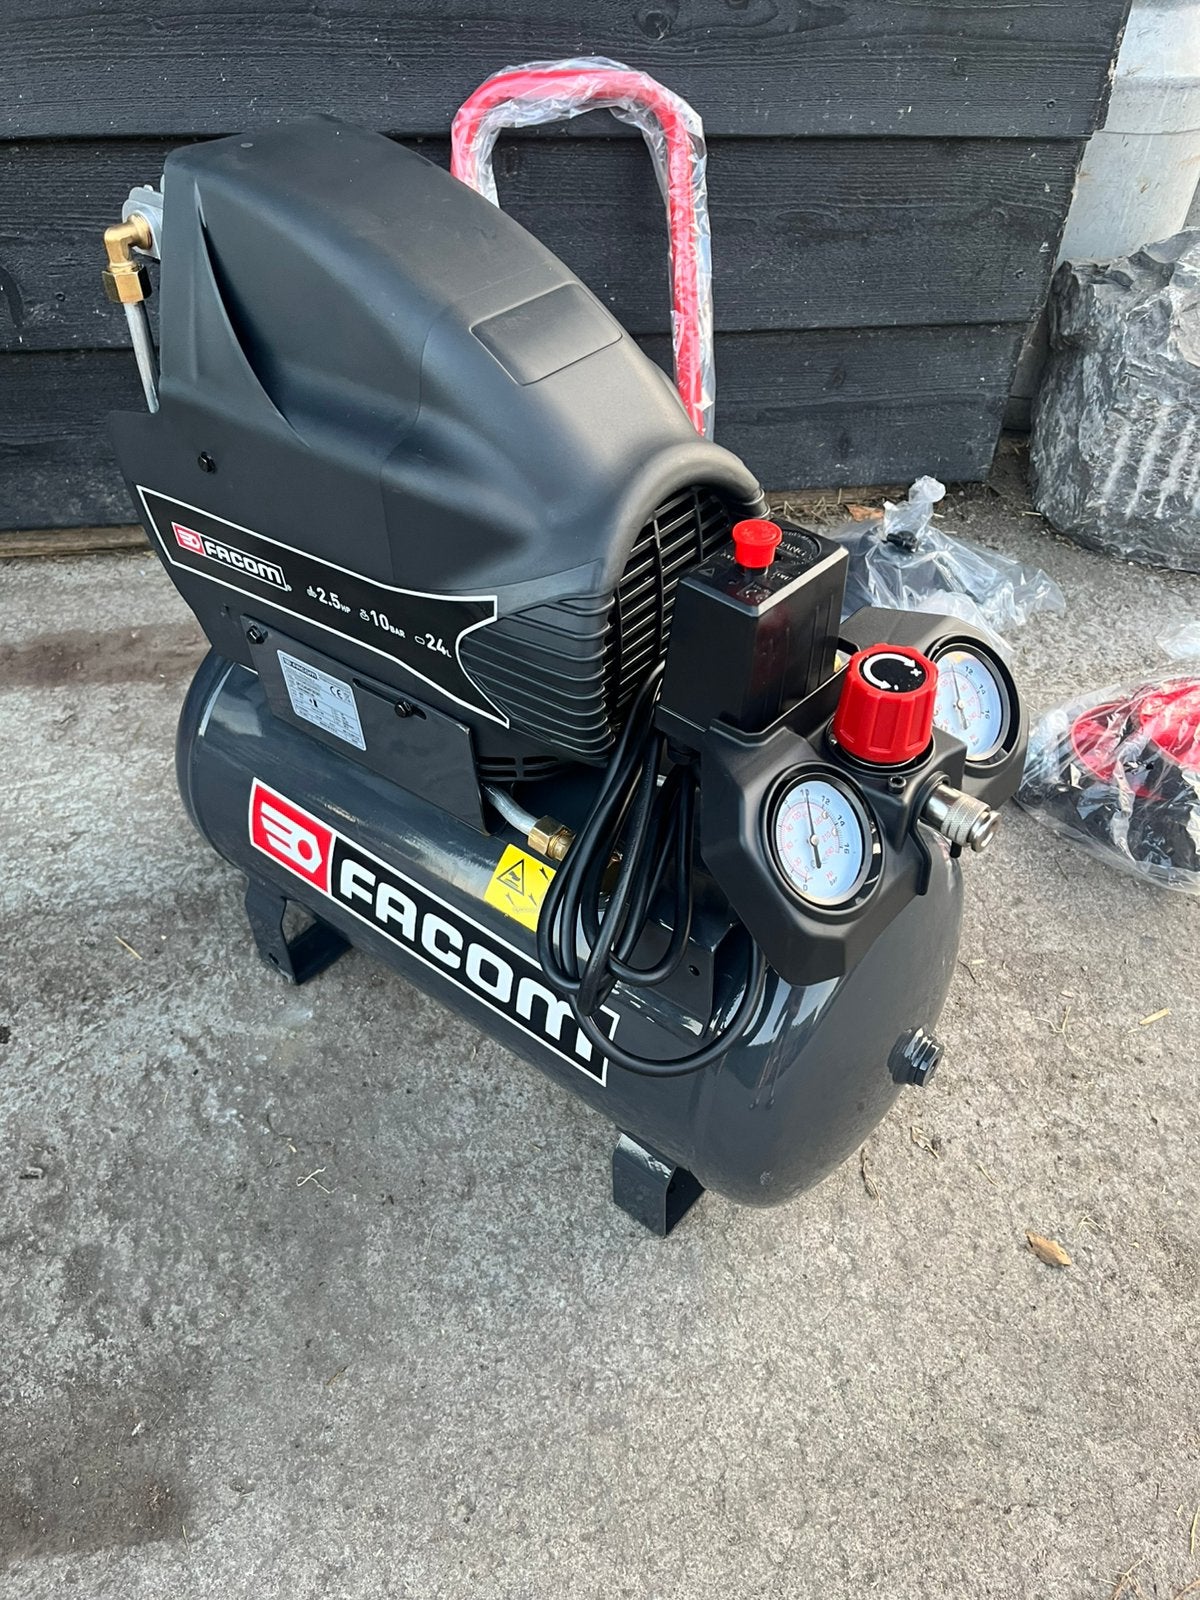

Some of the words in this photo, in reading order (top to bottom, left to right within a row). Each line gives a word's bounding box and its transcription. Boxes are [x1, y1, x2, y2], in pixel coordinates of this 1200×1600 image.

[204, 540, 282, 585] FACOM
[965, 666, 974, 676] 12
[821, 795, 831, 806] 12
[844, 843, 850, 854] 16
[802, 884, 809, 892] 0
[339, 858, 593, 1063] FACOM
